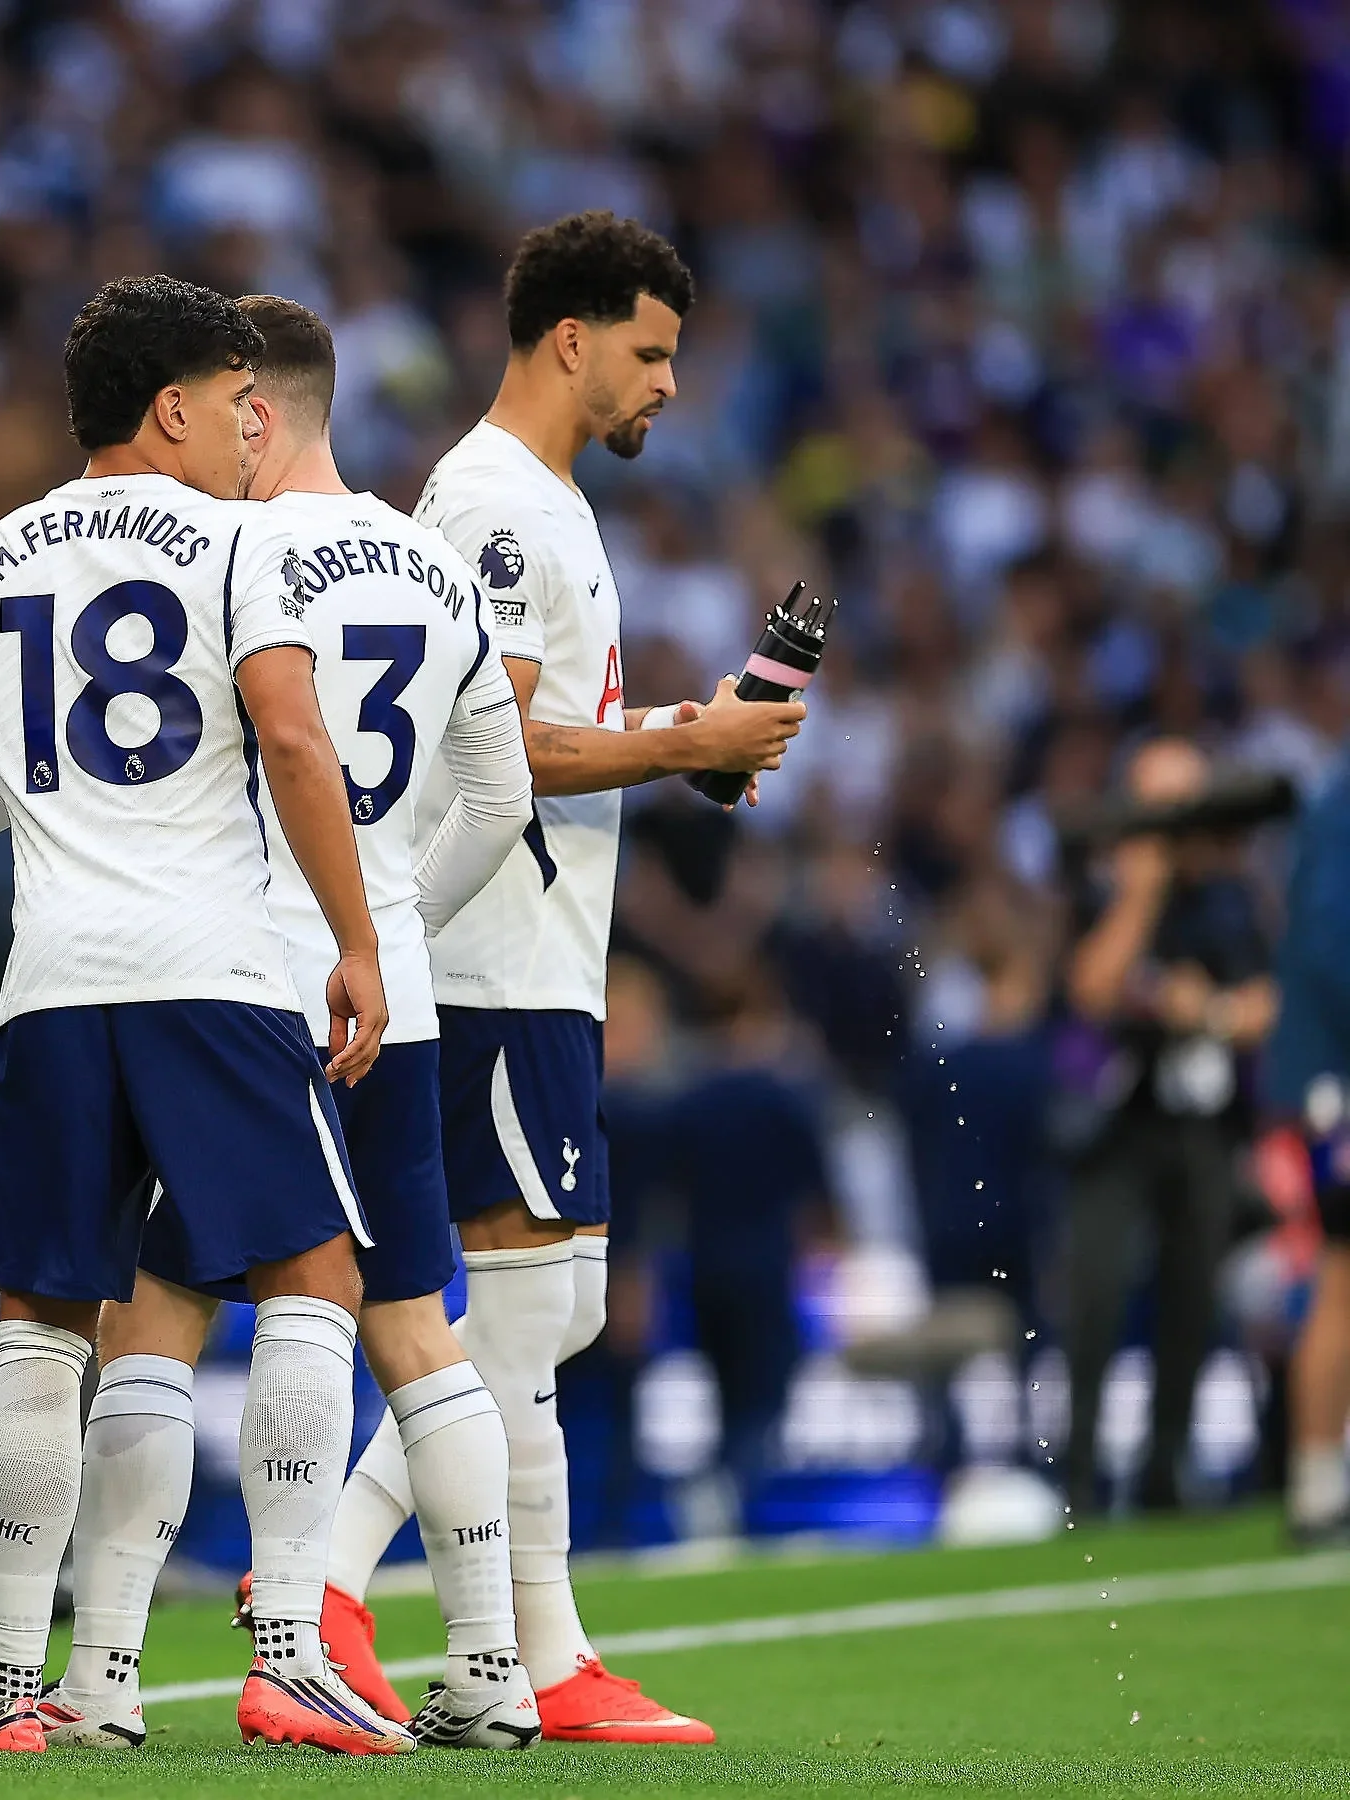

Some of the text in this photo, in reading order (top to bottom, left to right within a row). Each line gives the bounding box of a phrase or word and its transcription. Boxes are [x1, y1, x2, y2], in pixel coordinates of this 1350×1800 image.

[302, 539, 465, 621] OBERTSON
[492, 602, 522, 615] oom
[0, 580, 203, 794] 18
[340, 624, 426, 825] 3
[263, 1459, 317, 1485] THFC
[453, 1519, 502, 1546] THFC
